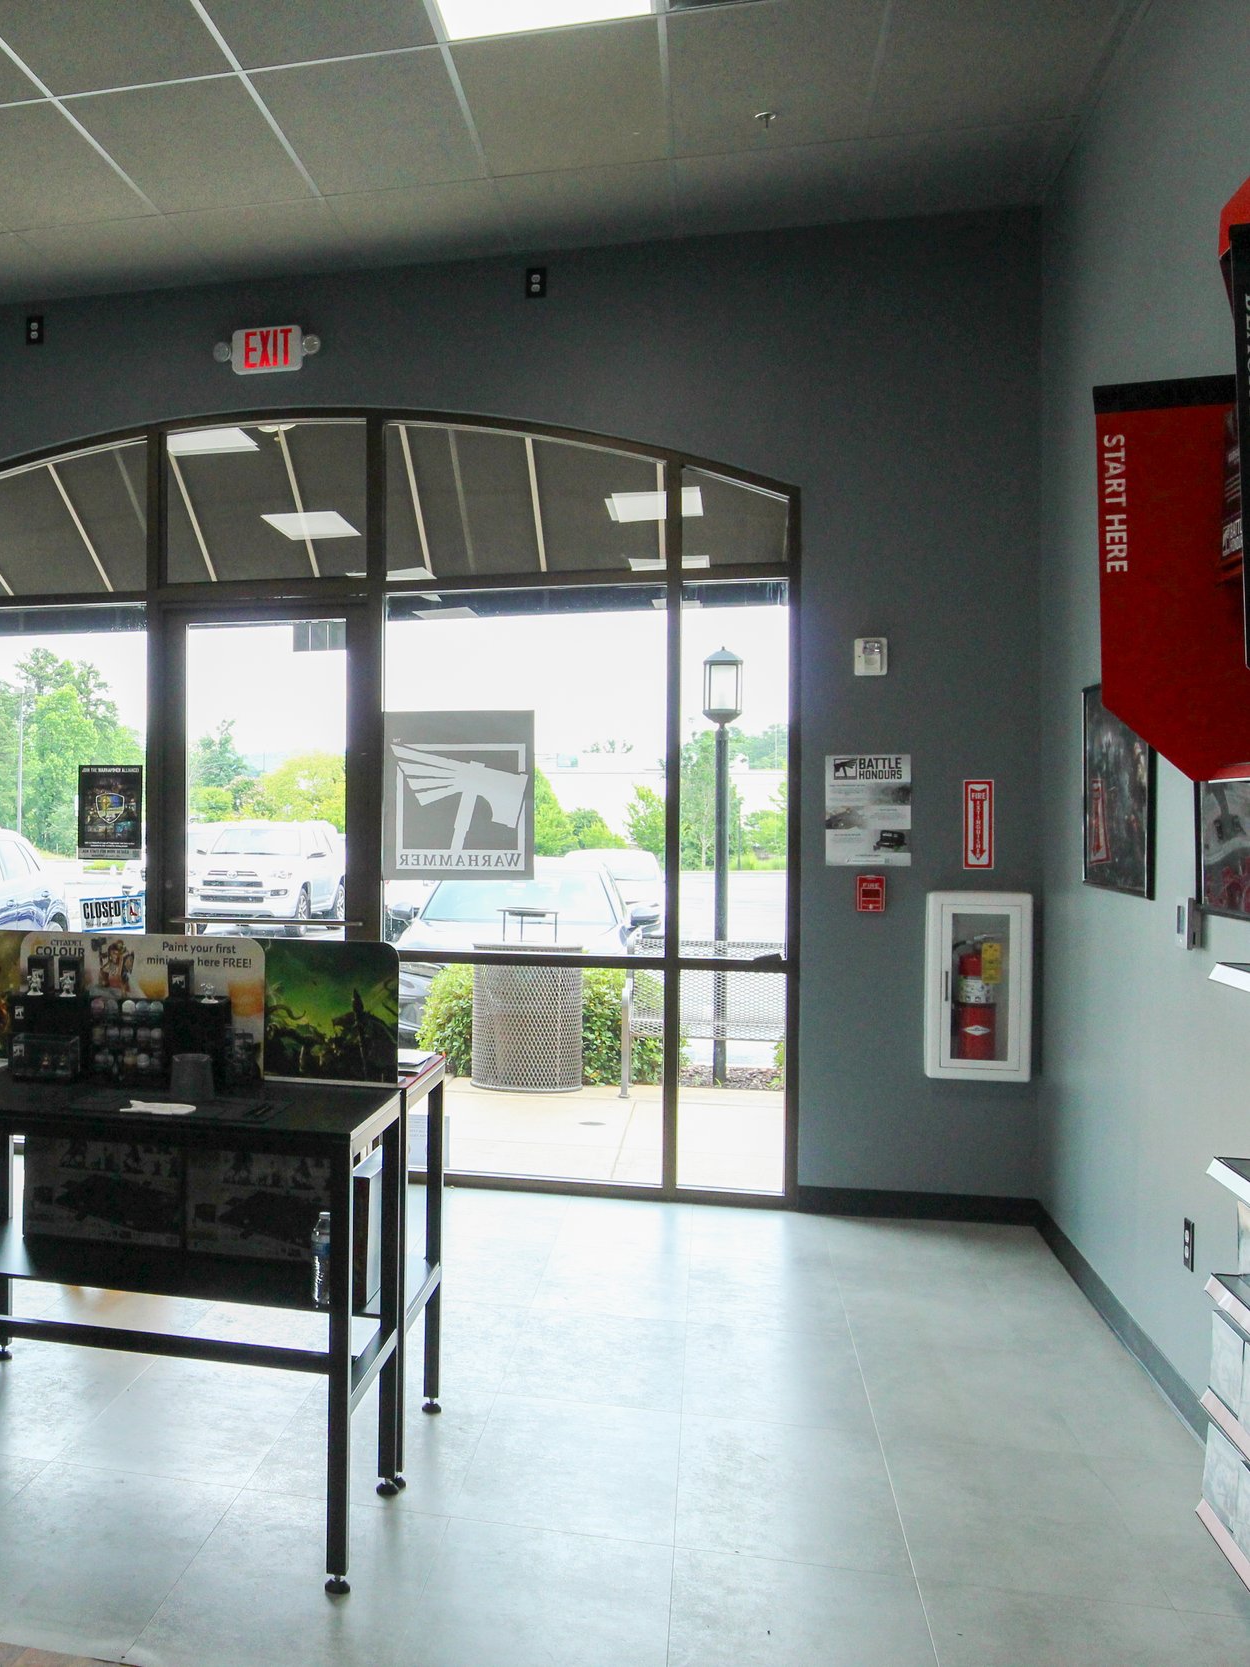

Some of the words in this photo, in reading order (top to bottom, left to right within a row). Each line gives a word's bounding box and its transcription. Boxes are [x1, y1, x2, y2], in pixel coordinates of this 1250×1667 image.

[244, 328, 292, 369] EXIT
[1103, 434, 1126, 507] START
[1105, 514, 1128, 573] HERE
[859, 758, 903, 769] BATTLE
[859, 770, 903, 780] HONOURS
[972, 792, 986, 800] FIRE
[83, 900, 121, 920] CLOSED
[36, 946, 85, 957] COLOUR
[162, 941, 188, 952] Paint
[190, 945, 213, 954] your
[216, 943, 236, 954] first
[197, 956, 220, 967] here
[223, 957, 252, 968] FREE!
